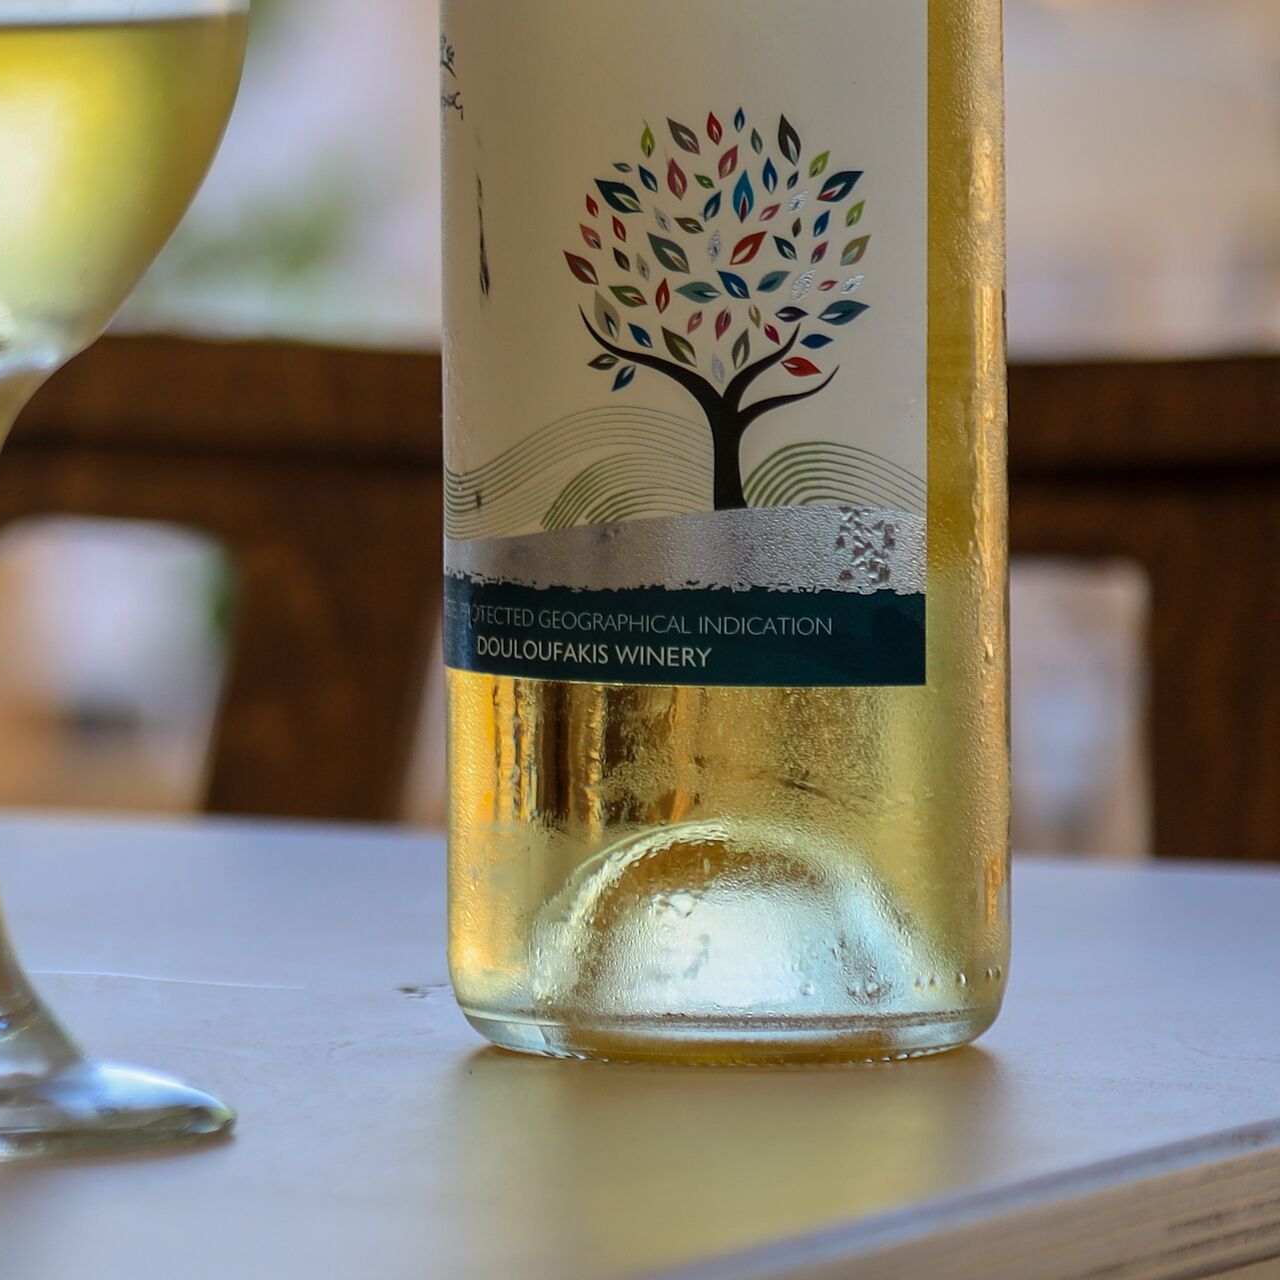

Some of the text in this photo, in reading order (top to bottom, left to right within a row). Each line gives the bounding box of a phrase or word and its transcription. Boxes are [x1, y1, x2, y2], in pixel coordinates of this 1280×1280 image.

[538, 609, 692, 634] GEOGRAPHICAL
[699, 616, 833, 636] INDICATION
[477, 634, 713, 668] DOULOUFAKIS WINERY
